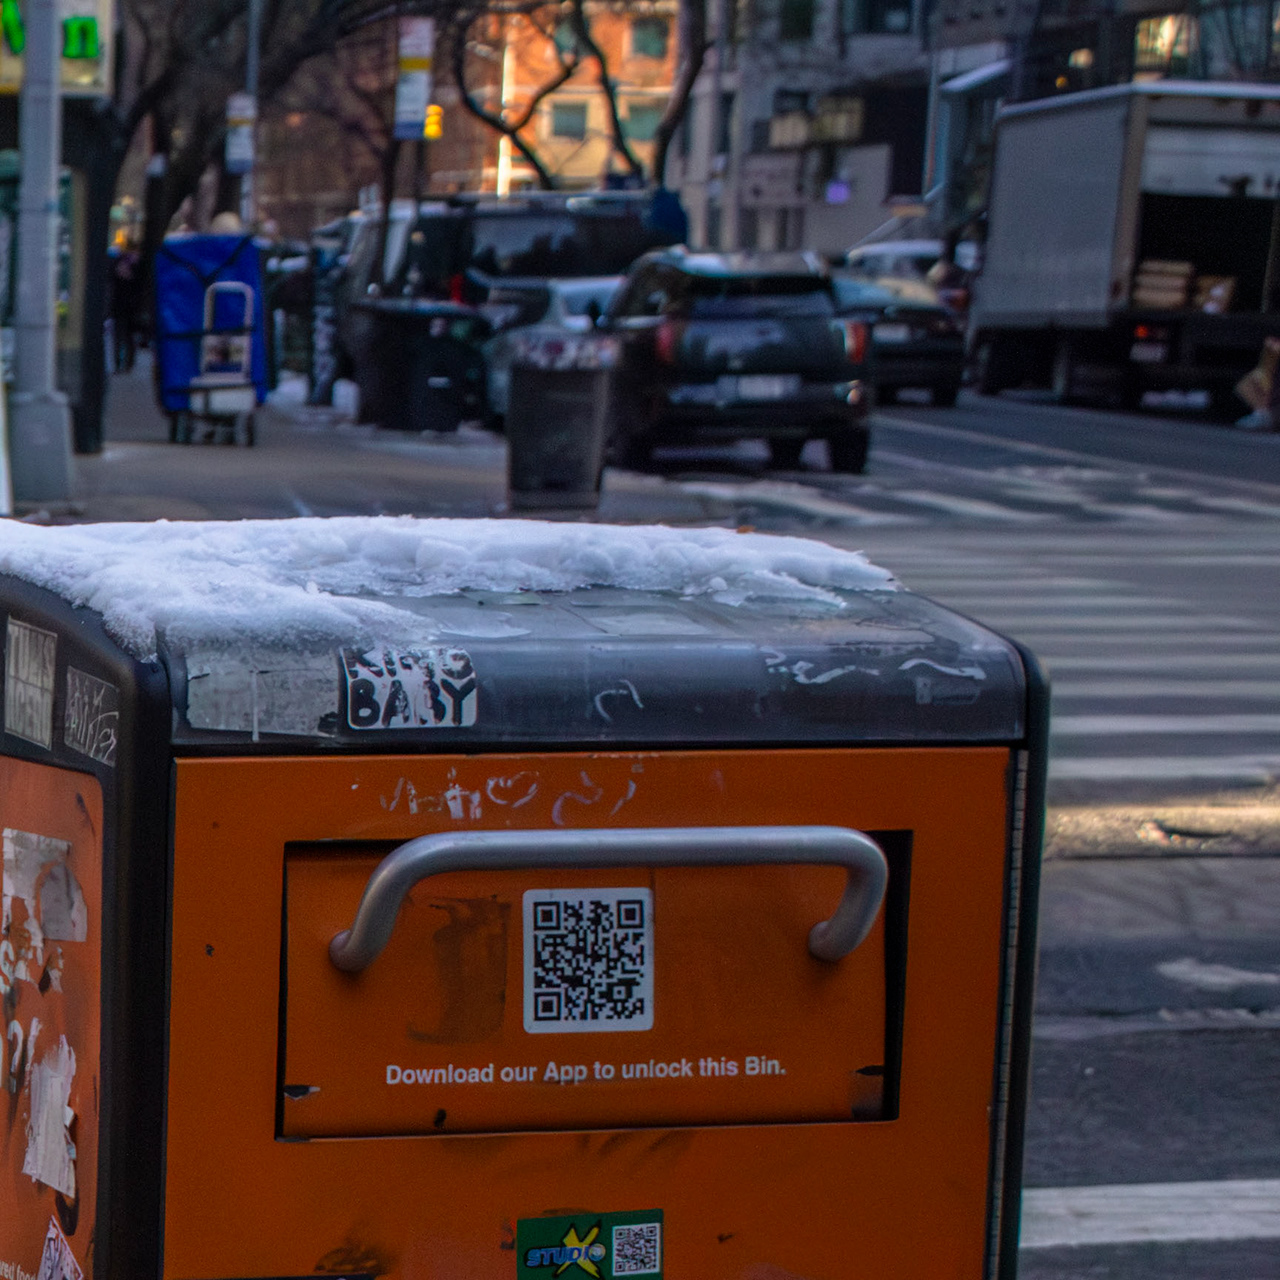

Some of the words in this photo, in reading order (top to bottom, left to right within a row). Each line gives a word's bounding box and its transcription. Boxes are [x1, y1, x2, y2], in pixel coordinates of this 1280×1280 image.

[385, 1062, 494, 1086] Download
[500, 1067, 538, 1083] our
[543, 1061, 588, 1086] App
[593, 1061, 615, 1081] to
[621, 1057, 694, 1080] unlock
[698, 1056, 740, 1077] this
[744, 1055, 787, 1077] Bin.
[526, 1244, 607, 1267] STUDIO
